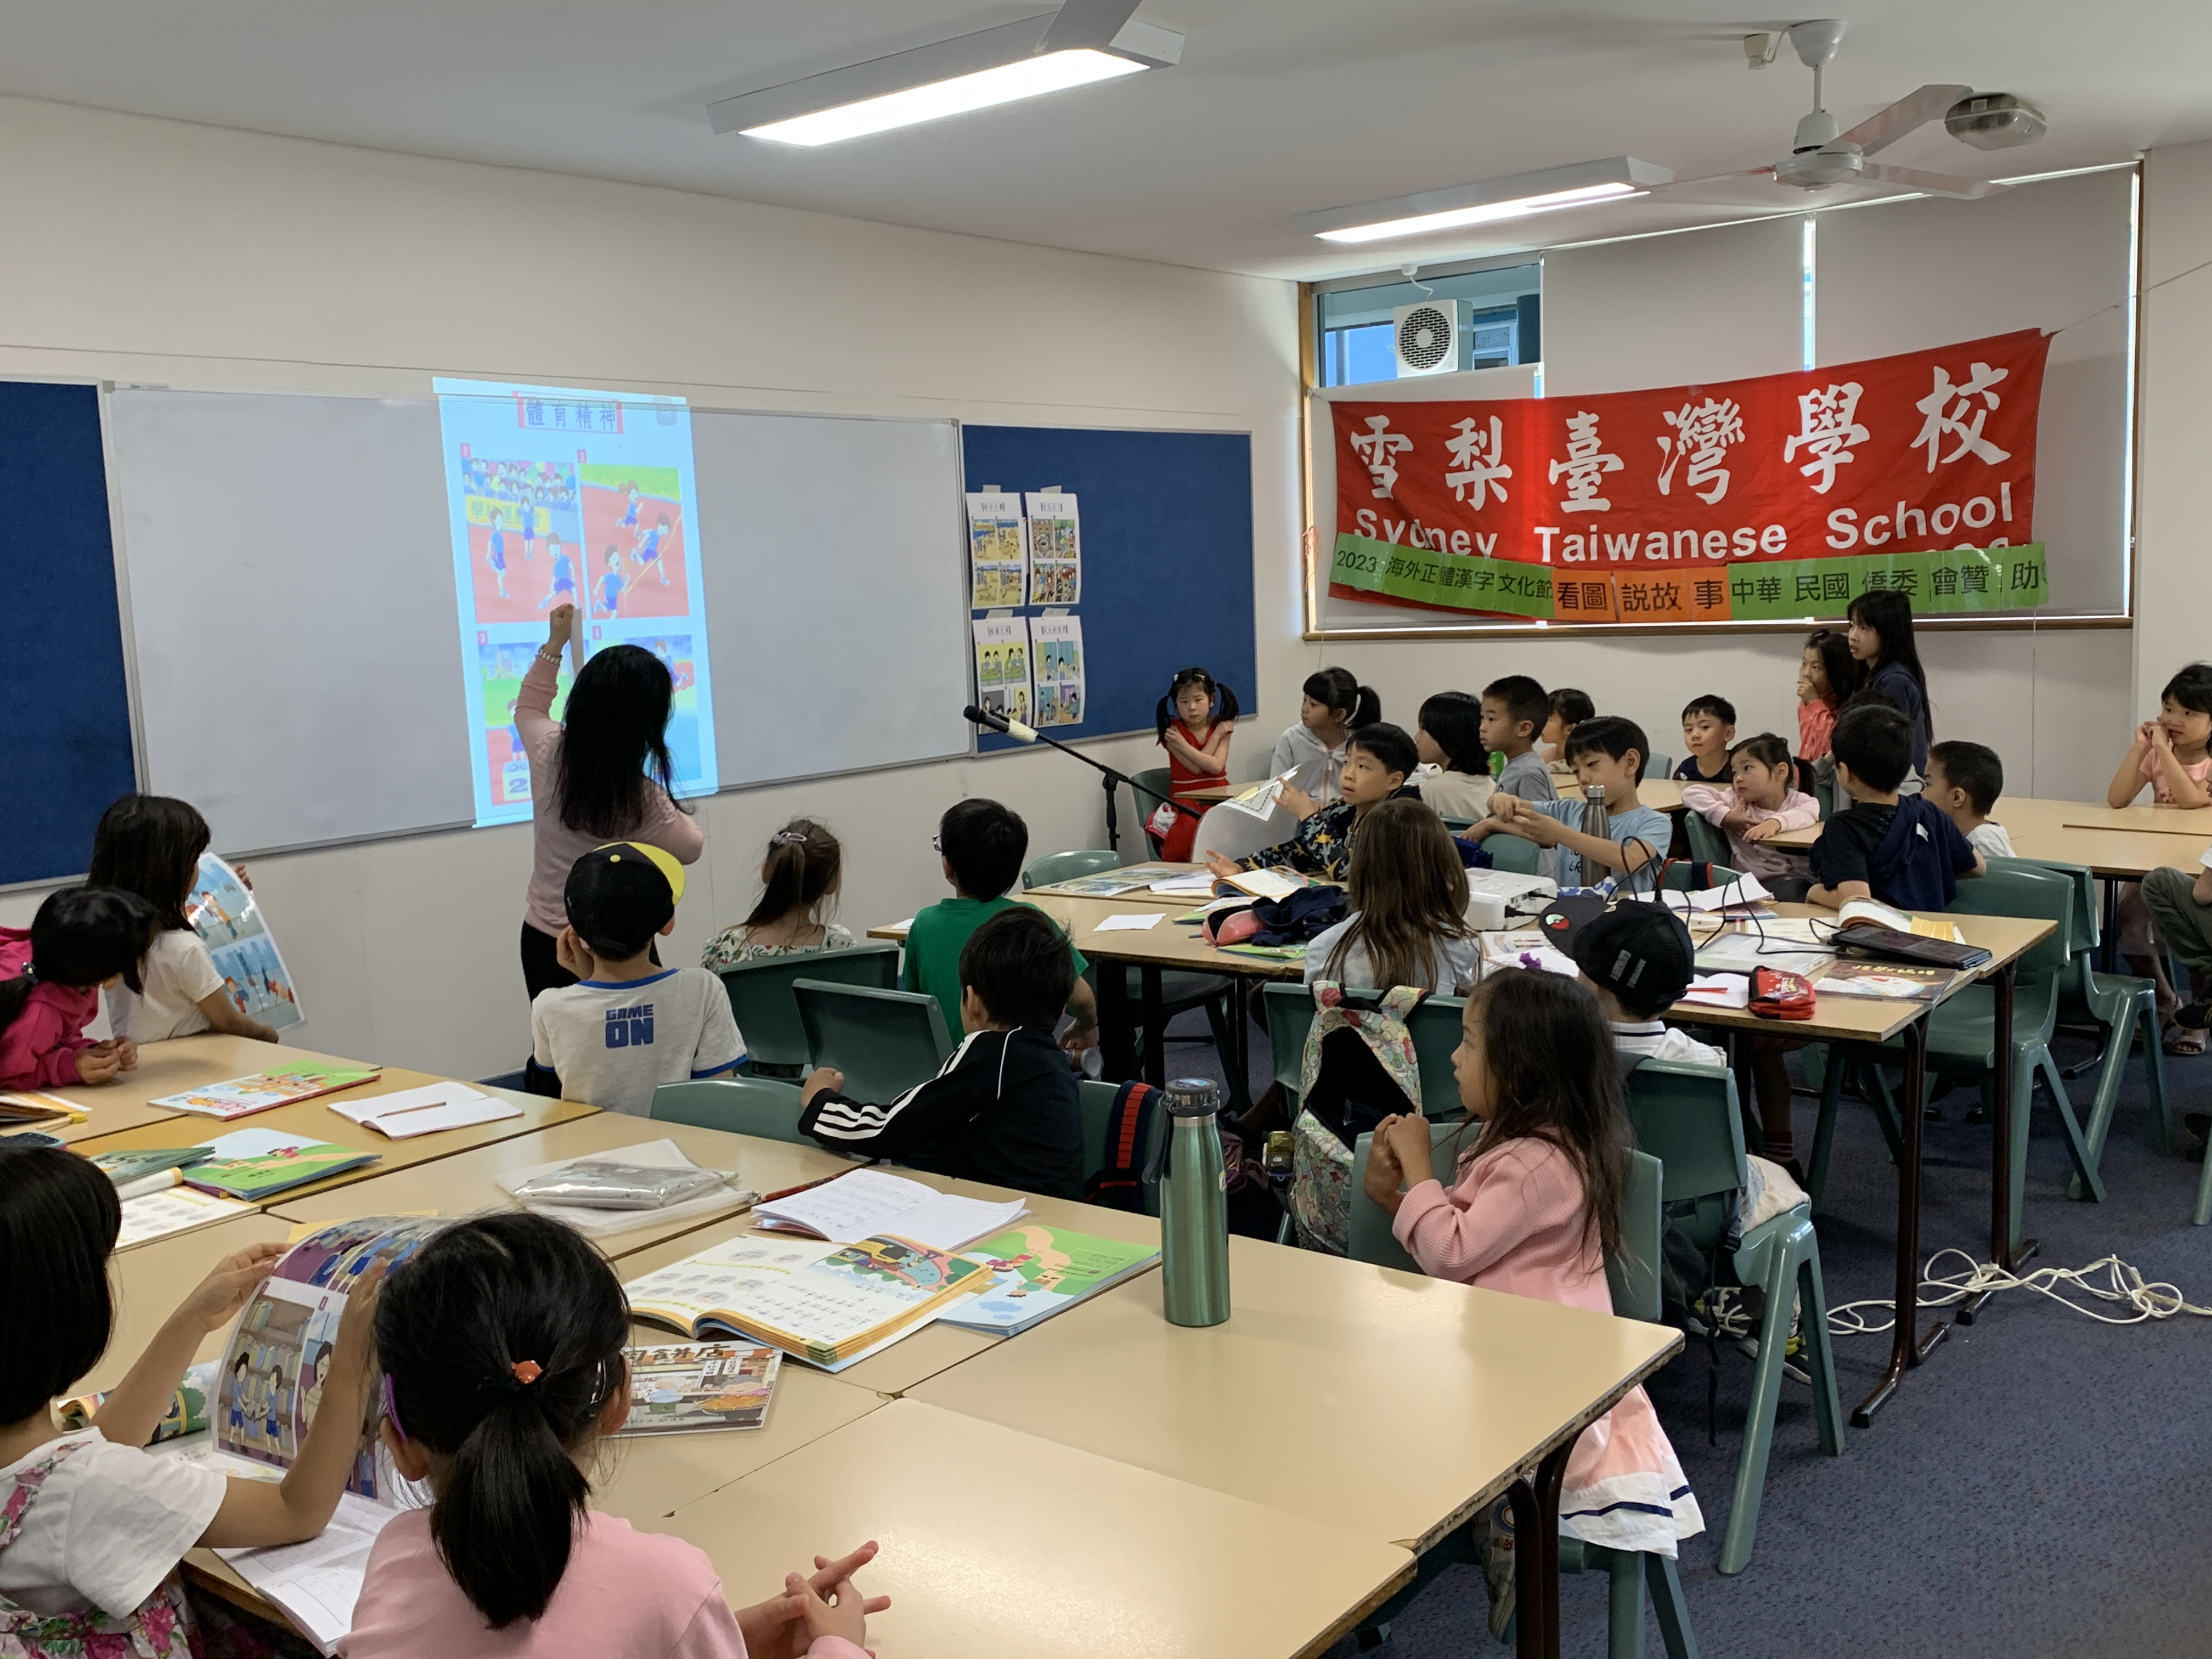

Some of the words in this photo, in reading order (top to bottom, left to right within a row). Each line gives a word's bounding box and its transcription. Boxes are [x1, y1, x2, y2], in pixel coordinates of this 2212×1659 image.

[526, 397, 616, 431] 體育精神
[1350, 362, 2012, 514] 雪梨臺灣學校
[1354, 508, 1498, 558] Sydney
[1534, 524, 1787, 563] Taiwanese
[1826, 482, 2013, 549] School
[1337, 550, 1377, 573] 2023
[509, 777, 528, 794] 2
[606, 1004, 653, 1021] GAME
[606, 1017, 654, 1048] ON
